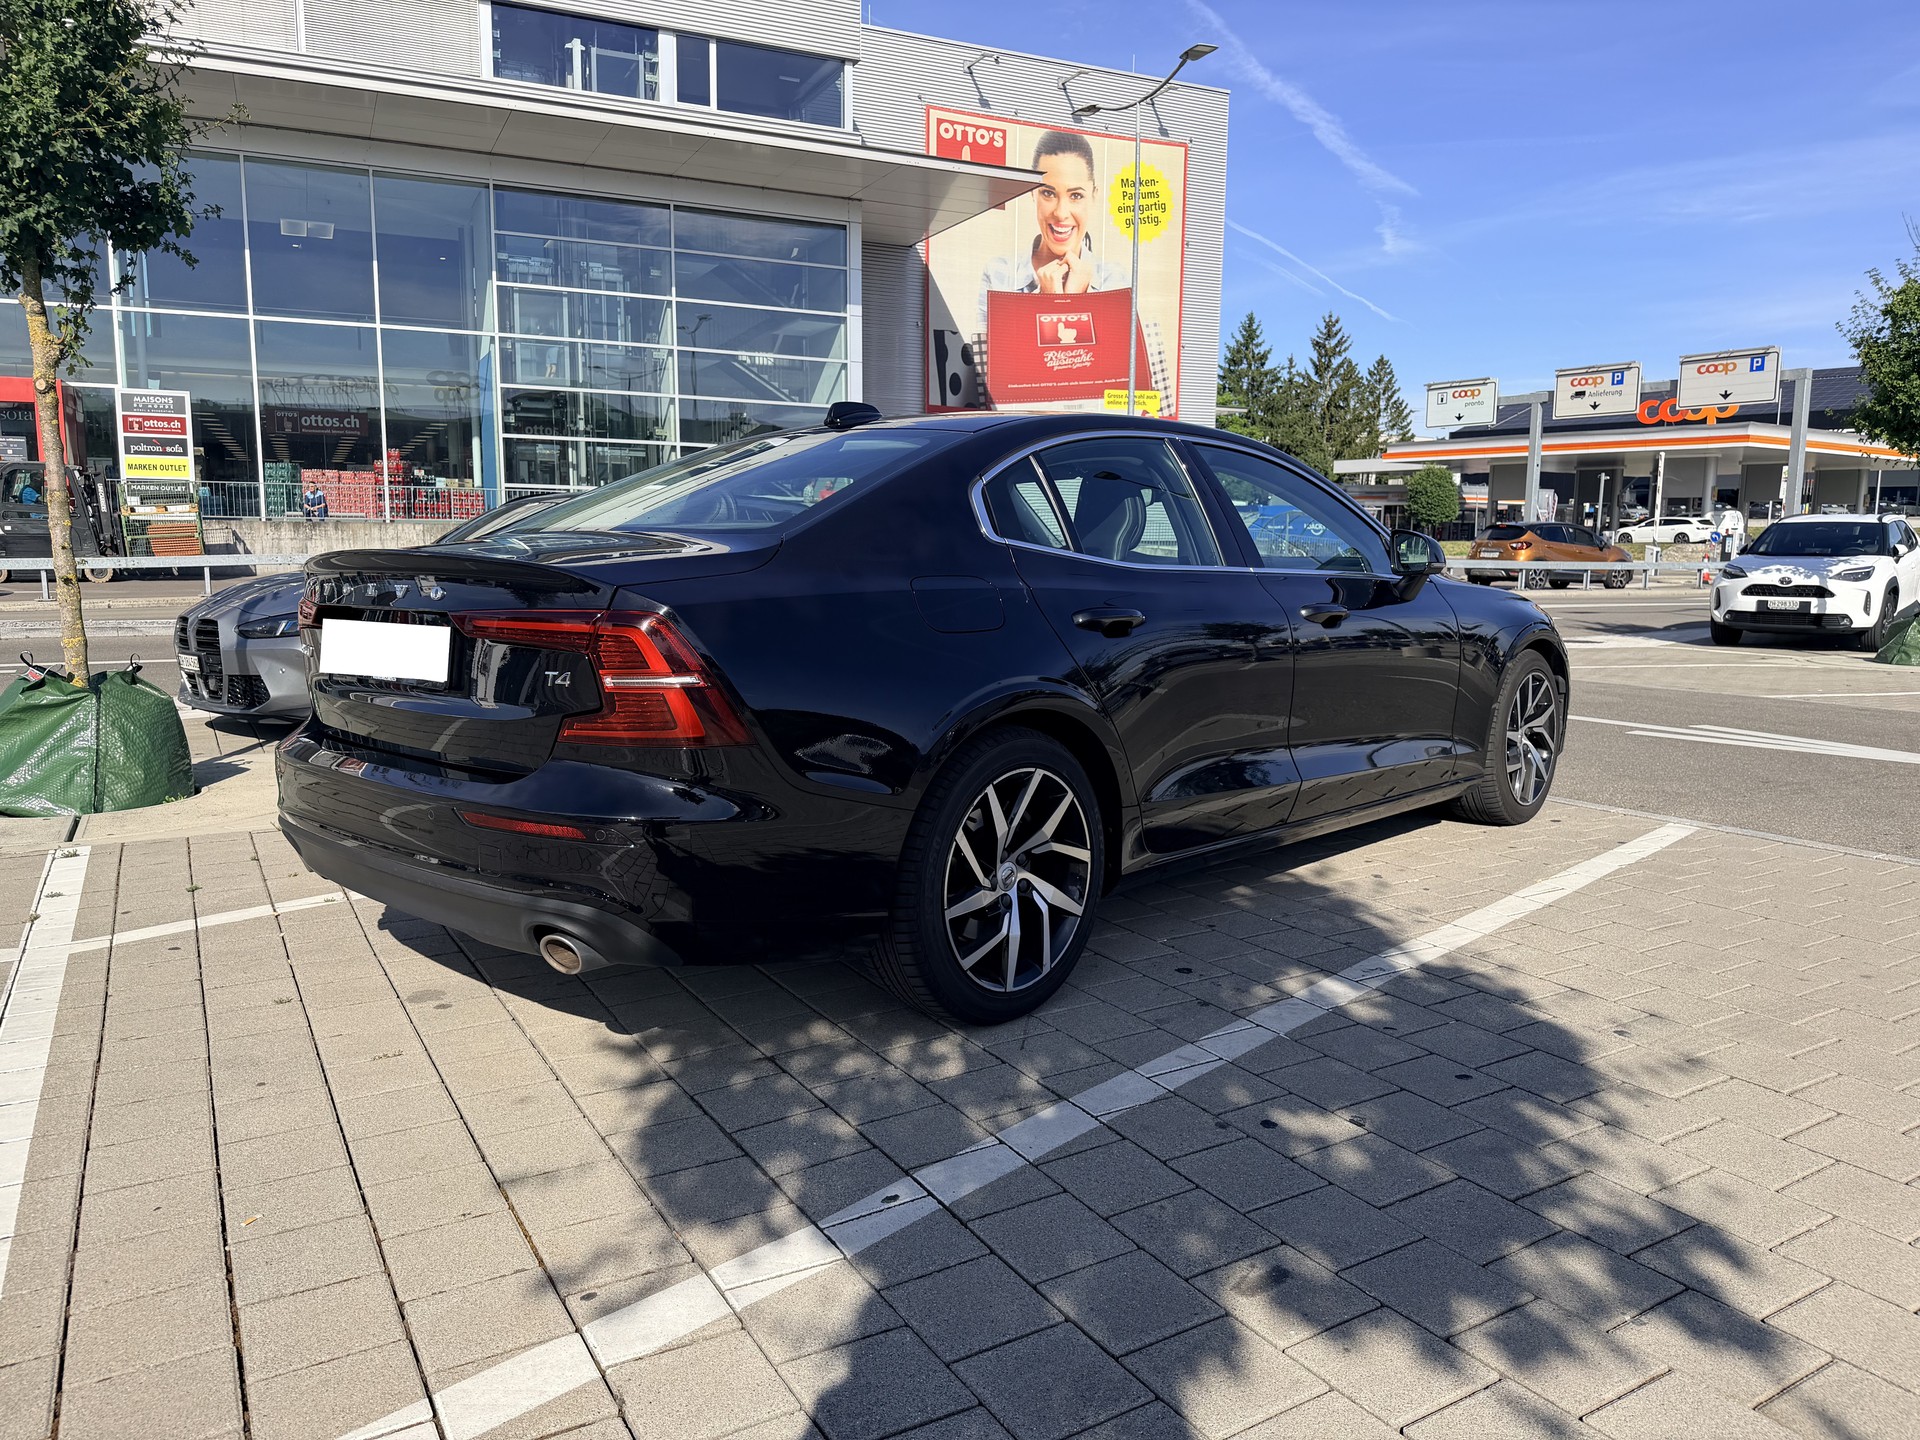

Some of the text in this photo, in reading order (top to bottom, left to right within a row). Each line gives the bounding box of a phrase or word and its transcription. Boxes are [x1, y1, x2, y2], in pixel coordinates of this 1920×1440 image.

[939, 122, 1004, 148] OTTO'S
[1121, 177, 1159, 188] Maken-
[1117, 200, 1166, 214] einzgartig
[1040, 314, 1089, 322] OTTO'S
[1043, 348, 1088, 361] Riesen-
[1697, 361, 1737, 375] coop
[1570, 376, 1604, 388] coop
[1452, 388, 1481, 399] coop
[1588, 389, 1622, 398] Anlieferung
[133, 396, 173, 404] MAISONS
[144, 419, 181, 428] ottos.ch
[301, 414, 360, 428] ottos.ch
[127, 463, 158, 471] MARKEN
[544, 671, 571, 687] T4
